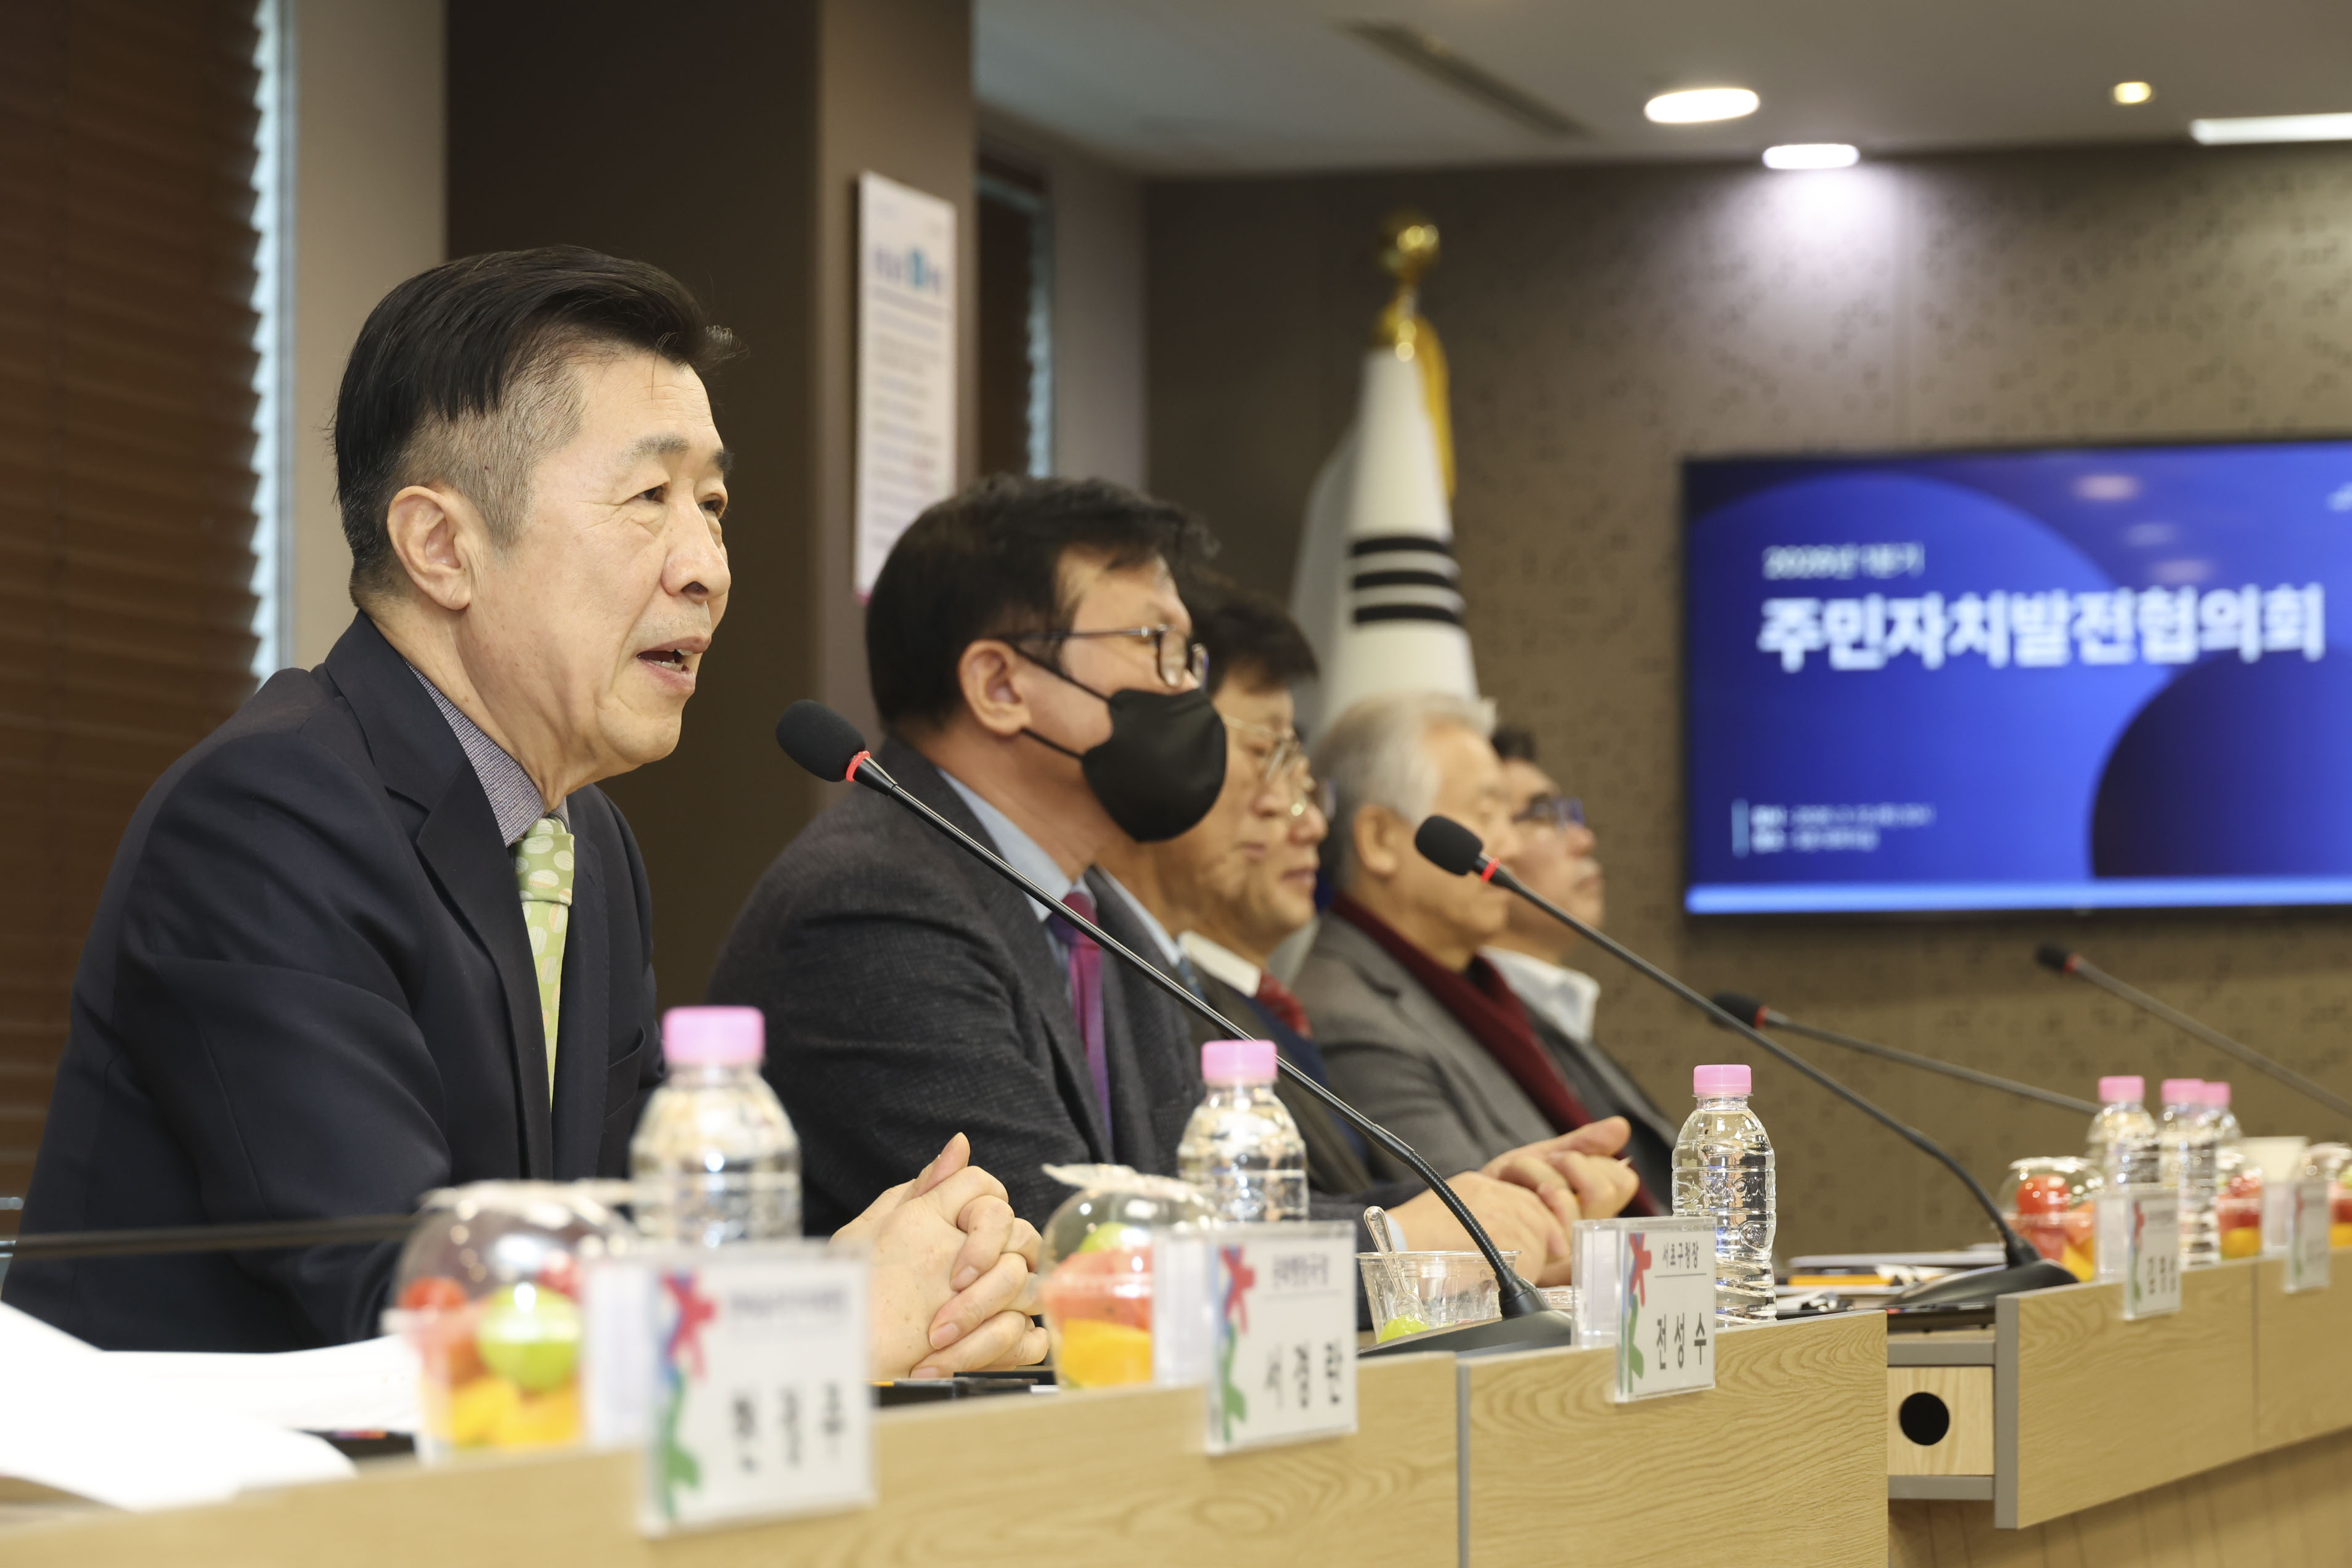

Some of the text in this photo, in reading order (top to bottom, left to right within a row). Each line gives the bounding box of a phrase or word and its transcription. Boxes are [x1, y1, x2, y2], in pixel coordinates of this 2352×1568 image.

[1758, 582, 2325, 673] 주민자치발전협의회
[1662, 1241, 1699, 1270] 서초구청장
[1656, 1312, 1707, 1370] 전성수
